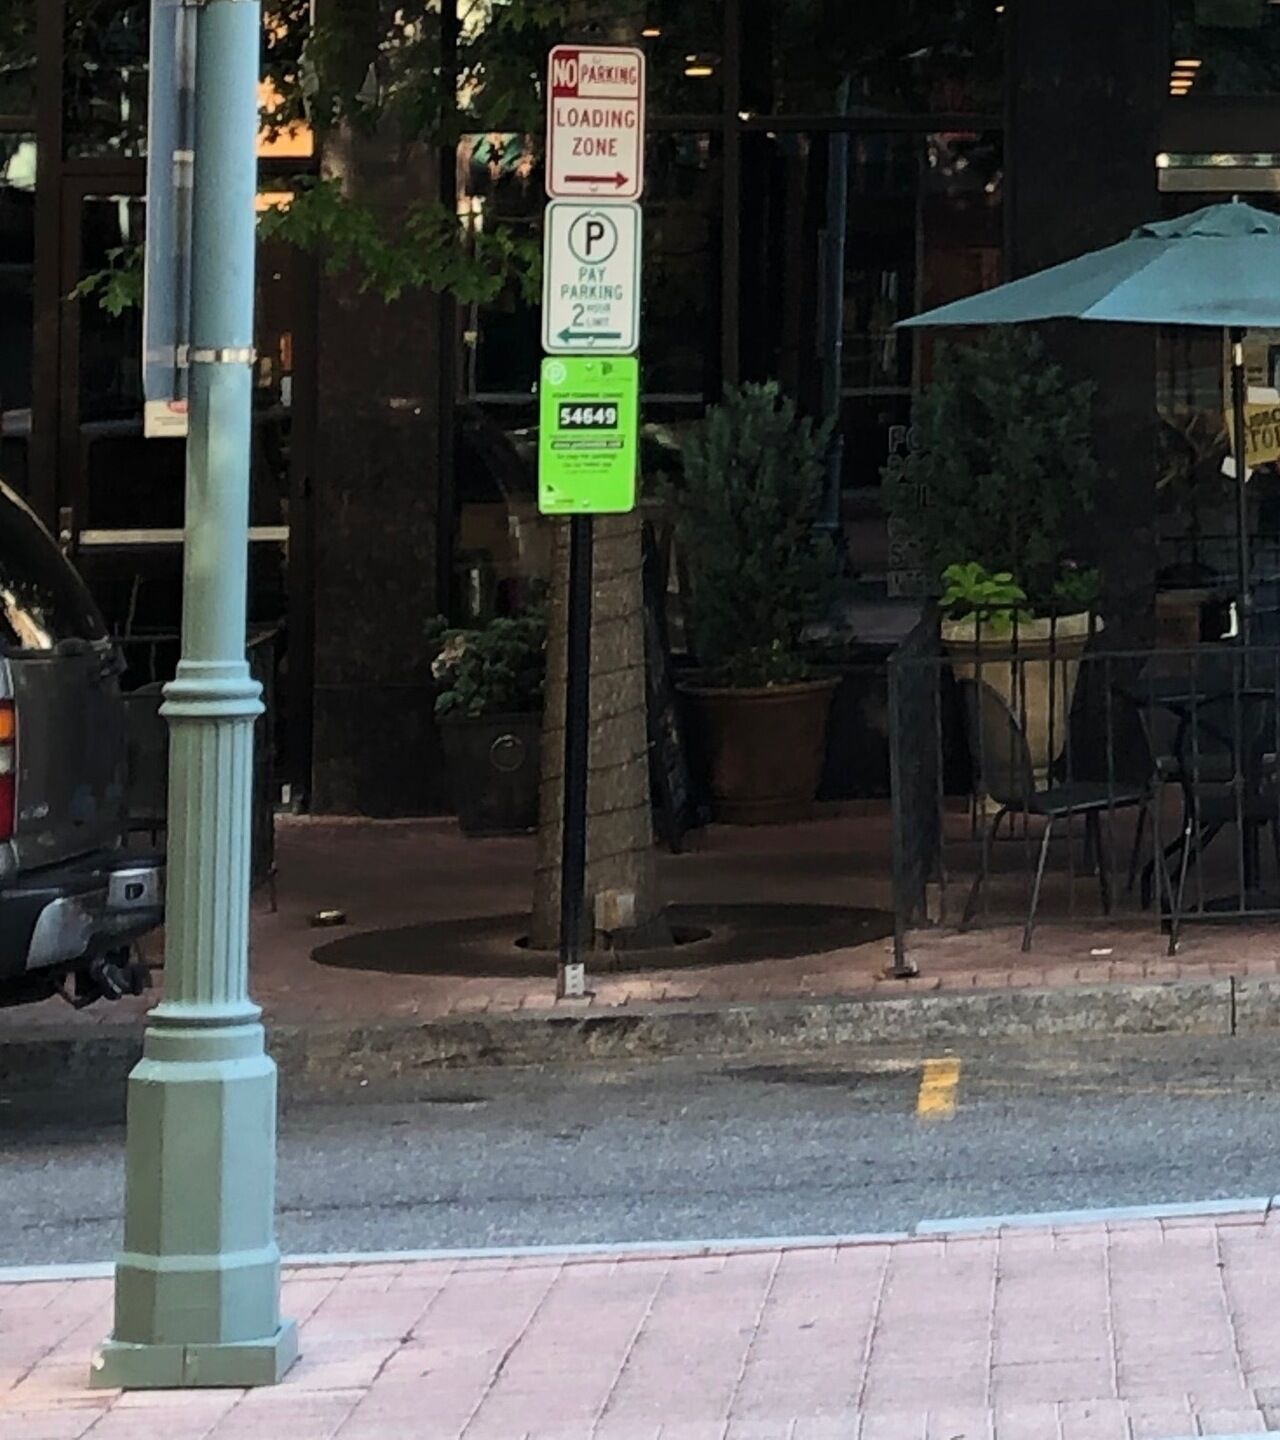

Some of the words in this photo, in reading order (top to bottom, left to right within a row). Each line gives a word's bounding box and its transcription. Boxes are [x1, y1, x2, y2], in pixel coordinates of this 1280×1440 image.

[553, 58, 578, 88] NO
[580, 63, 637, 85] PARKING
[556, 108, 636, 129] LOADING
[571, 136, 618, 157] ZONE
[585, 221, 605, 256] P
[578, 265, 607, 282] PAY
[560, 283, 624, 301] PARKING
[571, 303, 585, 327] 2
